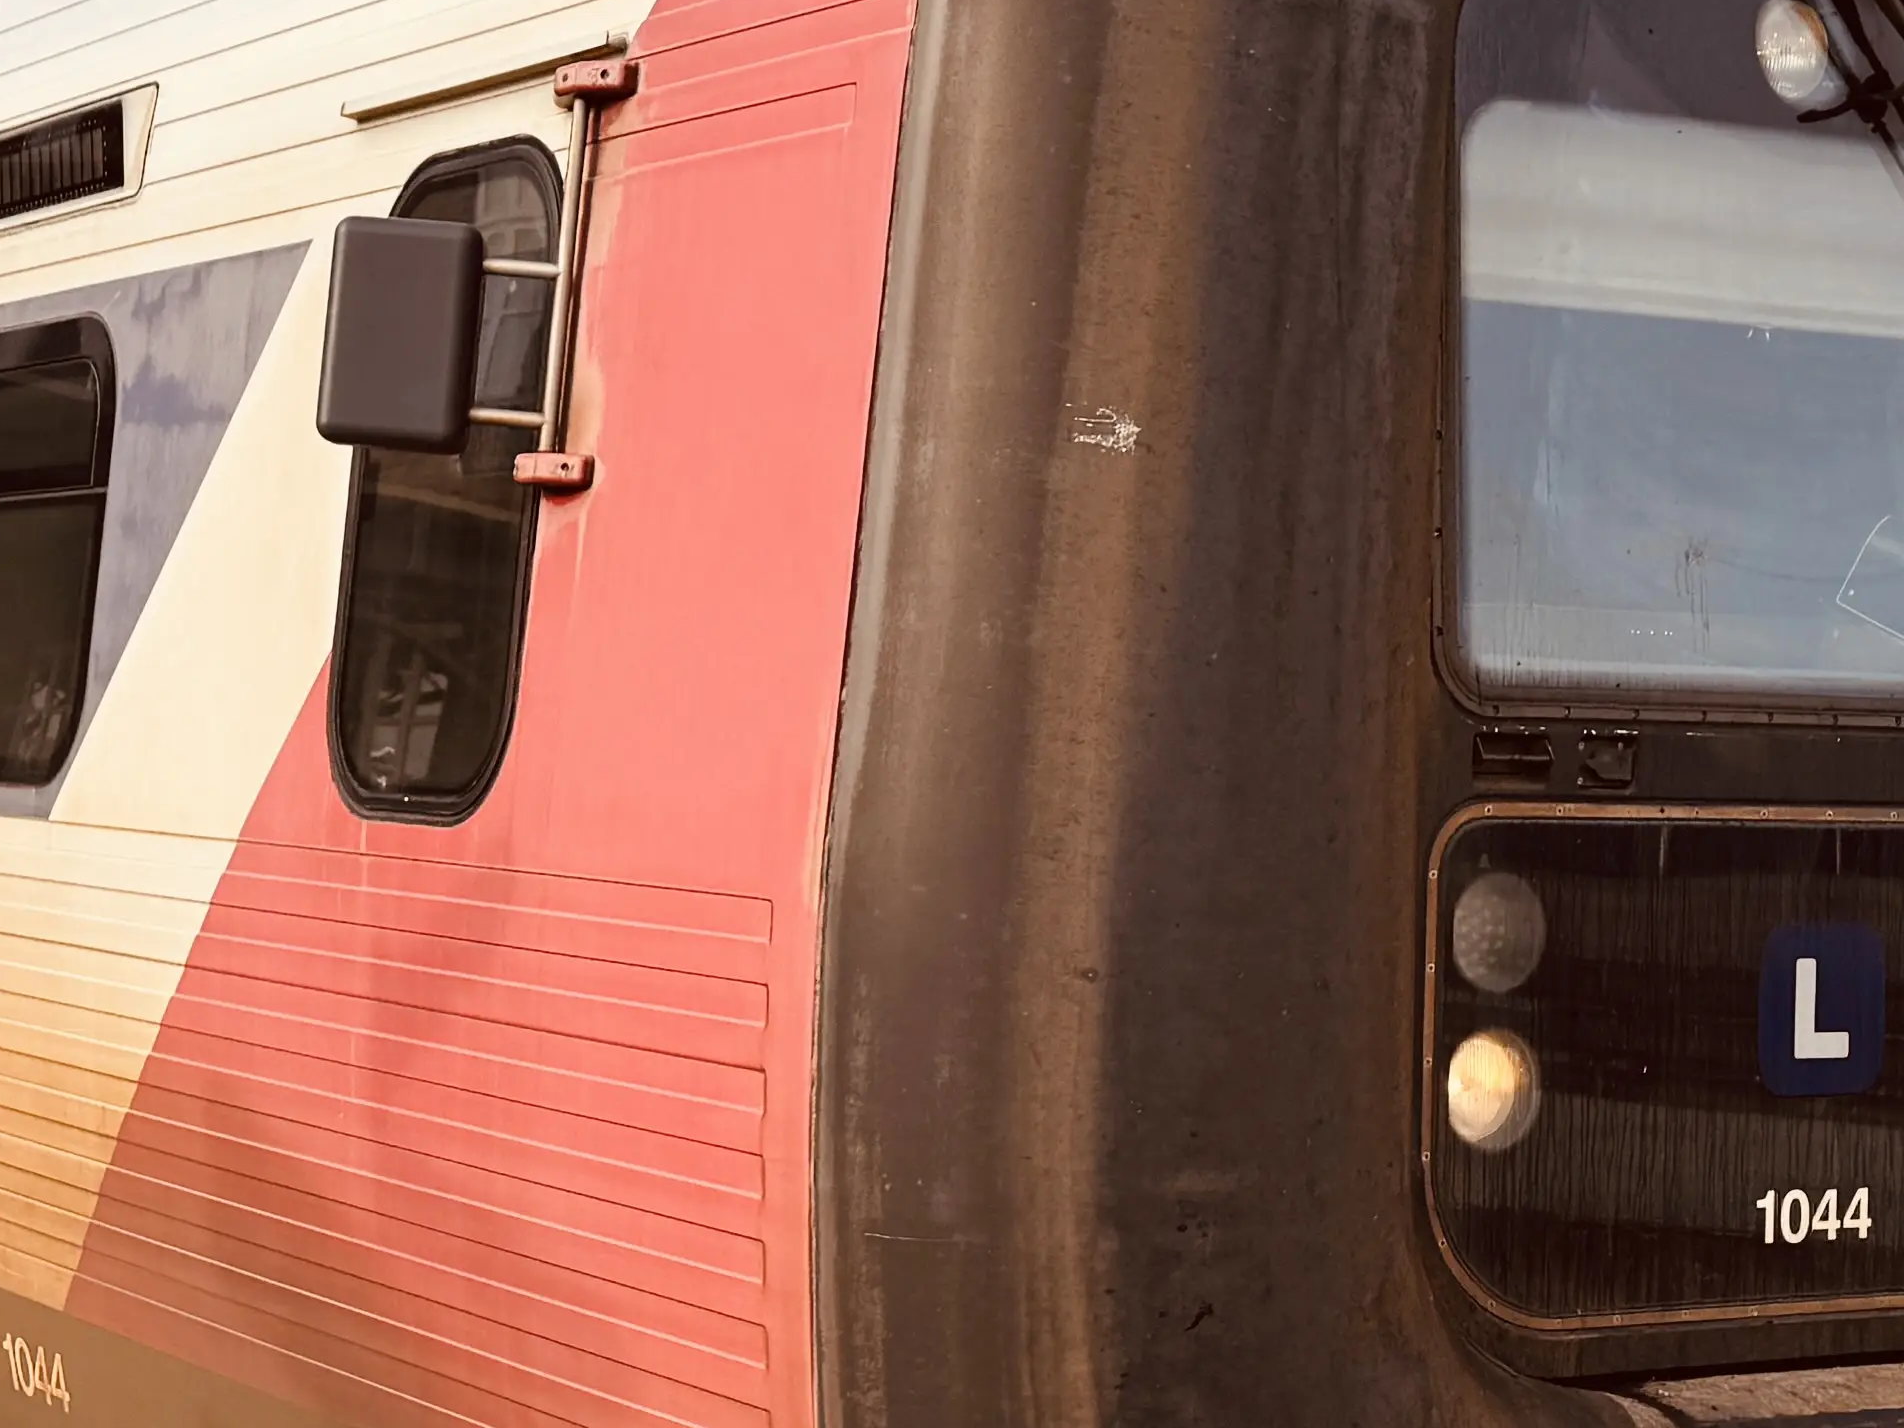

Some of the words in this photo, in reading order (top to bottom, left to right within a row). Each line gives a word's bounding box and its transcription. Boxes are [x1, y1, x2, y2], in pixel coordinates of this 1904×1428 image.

[1794, 957, 1850, 1060] L
[1755, 1186, 1873, 1244] 1044
[2, 1332, 71, 1414] 1044
